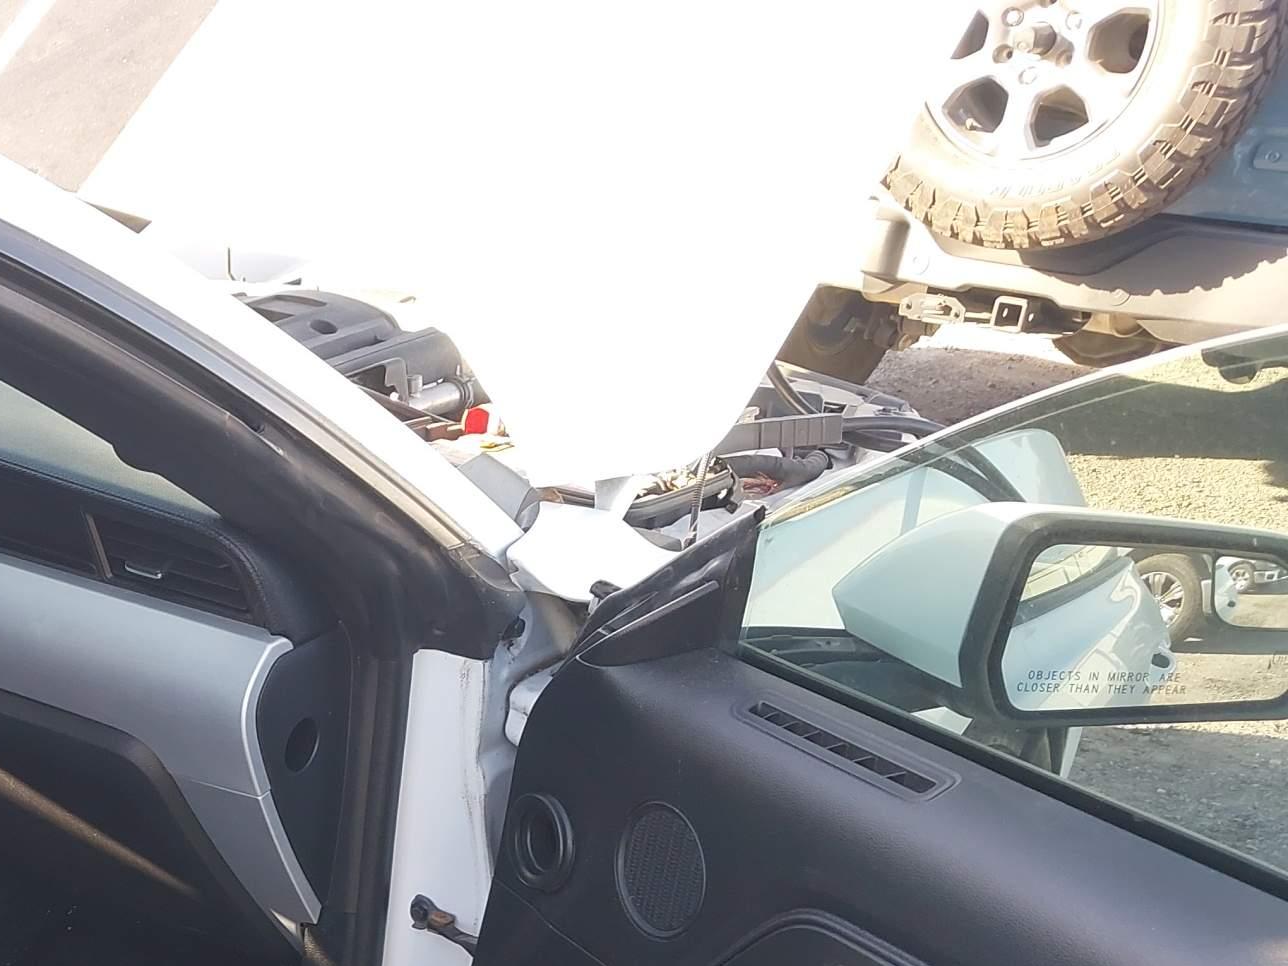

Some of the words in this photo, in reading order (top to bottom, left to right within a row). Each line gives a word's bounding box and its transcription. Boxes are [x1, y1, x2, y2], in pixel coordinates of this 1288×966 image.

[1028, 670, 1081, 681] OBJECTS
[1088, 671, 1099, 681] IN
[1107, 671, 1150, 682] MIRROR
[1158, 672, 1181, 682] ARE
[1016, 681, 1060, 693] CLOSER
[1068, 683, 1099, 694] THAN
[1108, 684, 1135, 694] THEY
[1142, 685, 1186, 695] APPEAR
